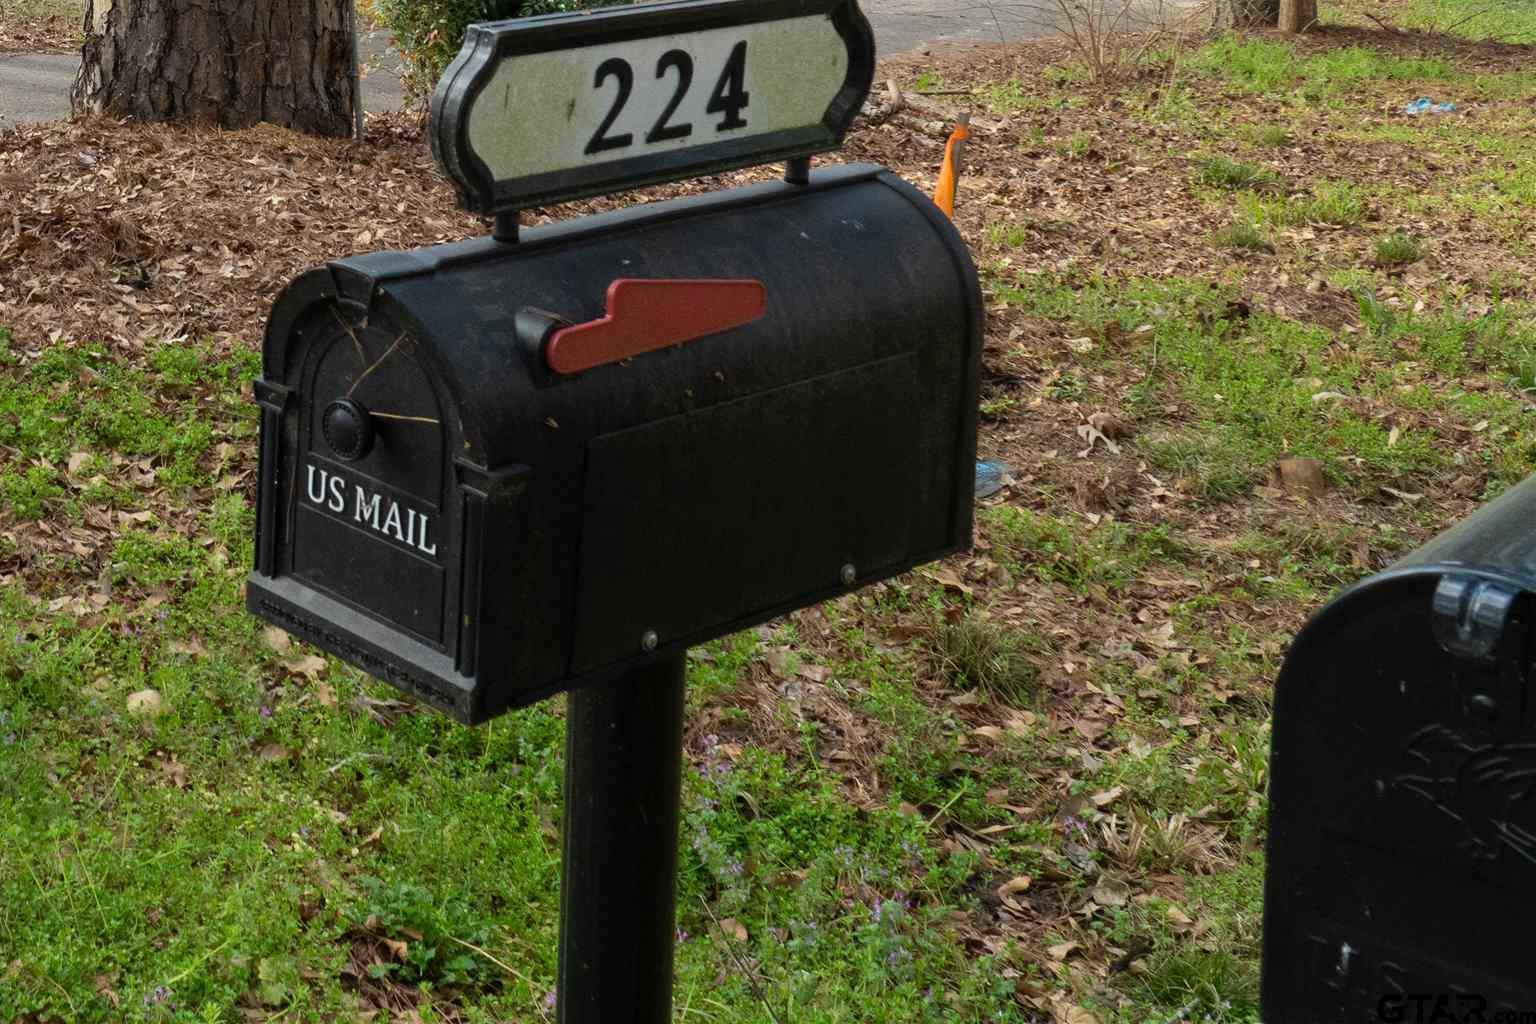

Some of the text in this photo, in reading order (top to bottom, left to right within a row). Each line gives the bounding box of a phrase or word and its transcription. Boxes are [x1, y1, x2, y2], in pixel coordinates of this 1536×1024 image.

[584, 39, 750, 156] 224
[307, 464, 437, 556] US MAIL
